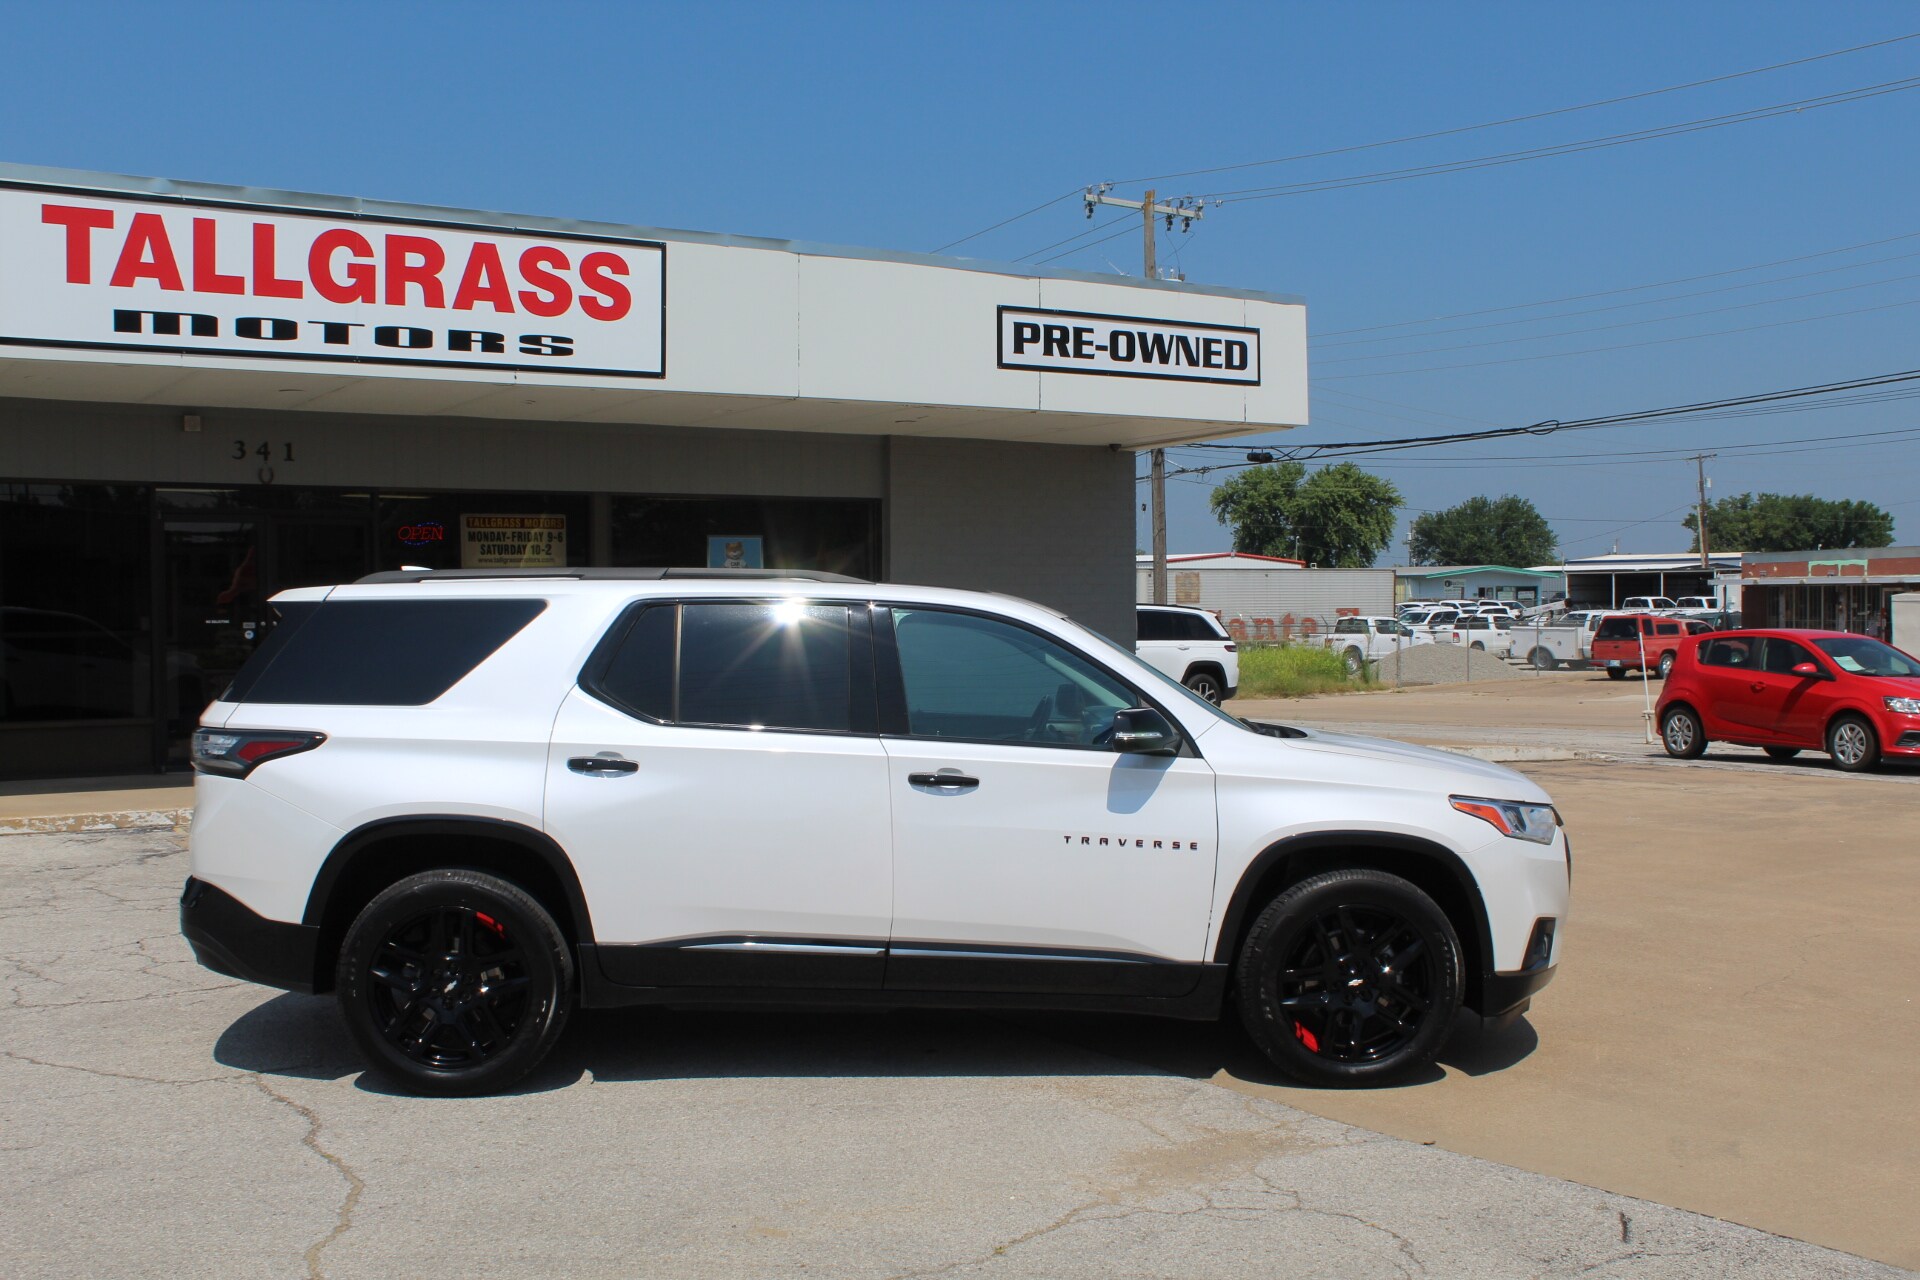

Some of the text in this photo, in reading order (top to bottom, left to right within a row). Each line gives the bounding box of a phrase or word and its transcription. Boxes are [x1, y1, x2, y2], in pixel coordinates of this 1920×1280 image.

[41, 203, 632, 322] TALLGRASS
[113, 308, 575, 357] MOTORS
[1013, 321, 1248, 371] PRE-OWNED
[468, 518, 563, 528] TALLGRASS MOTORS
[397, 526, 444, 540] OPEN
[467, 531, 563, 542] MONDAY-FRIDAY 9-6
[480, 544, 552, 555] SATURDAY 10-2
[1206, 610, 1318, 641] anta
[1063, 835, 1198, 850] TRAVERSE
